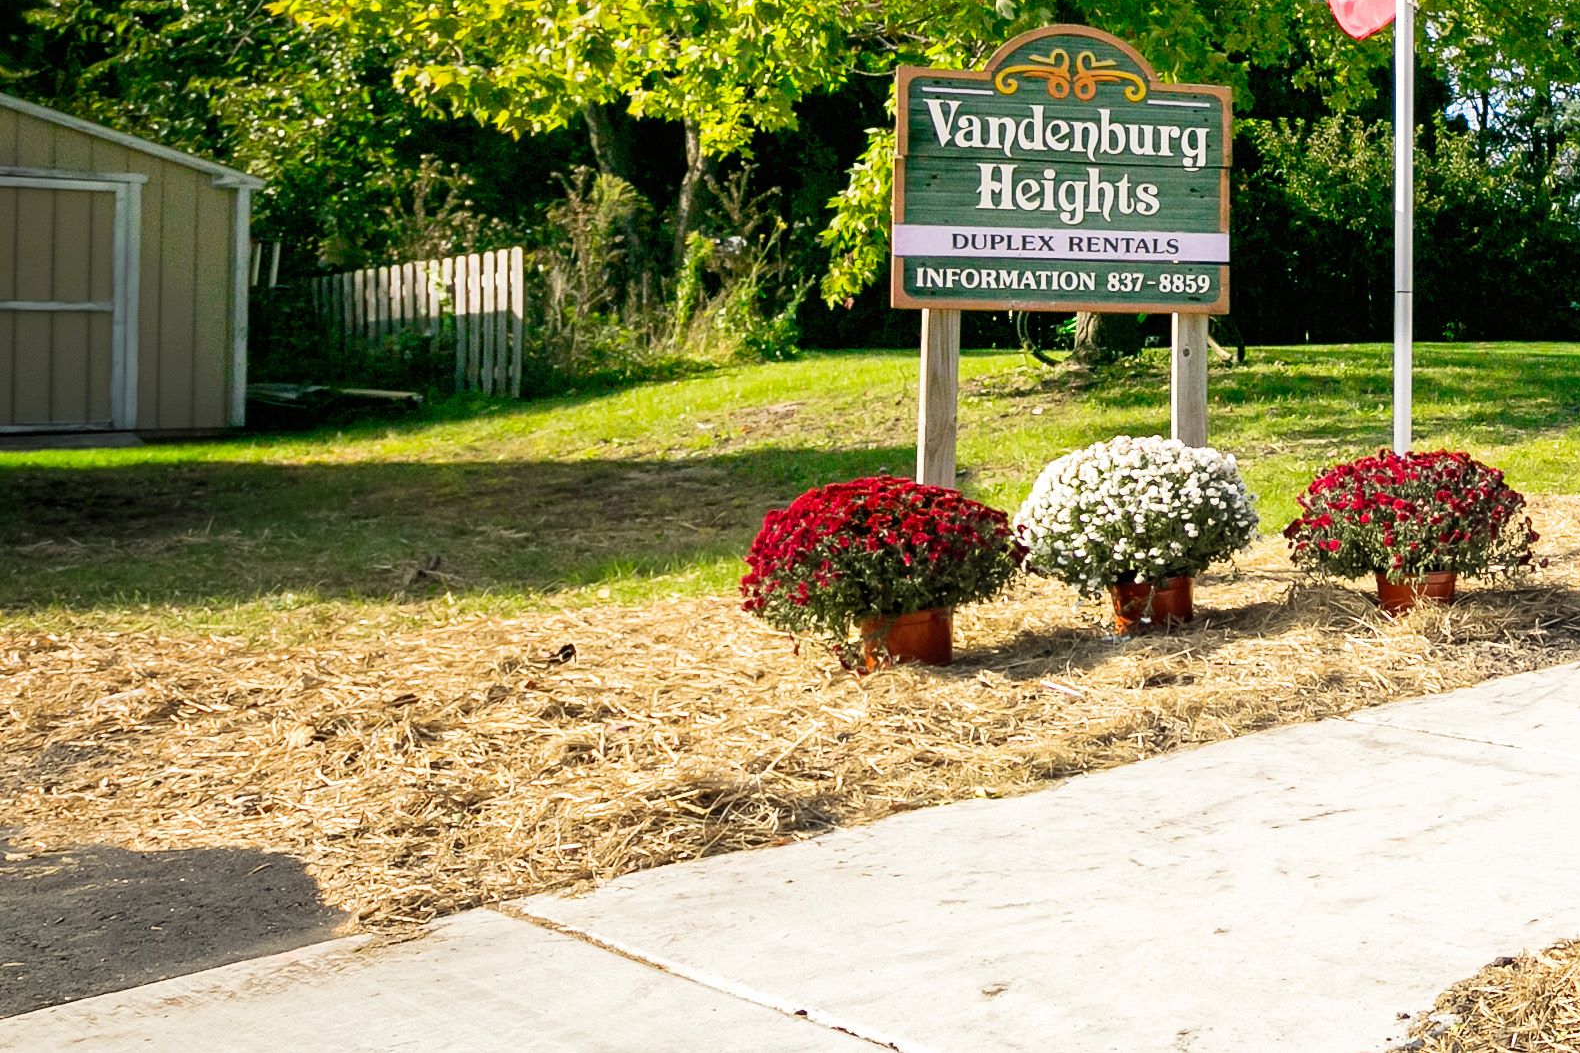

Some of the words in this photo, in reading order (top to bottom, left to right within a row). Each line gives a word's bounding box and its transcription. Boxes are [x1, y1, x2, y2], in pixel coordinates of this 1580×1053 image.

[923, 98, 1210, 171] Vandenburg
[975, 162, 1160, 225] Heights
[951, 233, 1055, 252] DUPLEX
[1068, 236, 1180, 255] RENTALS
[915, 267, 1096, 291] INFORMATION
[1107, 272, 1210, 294] 837-8859
